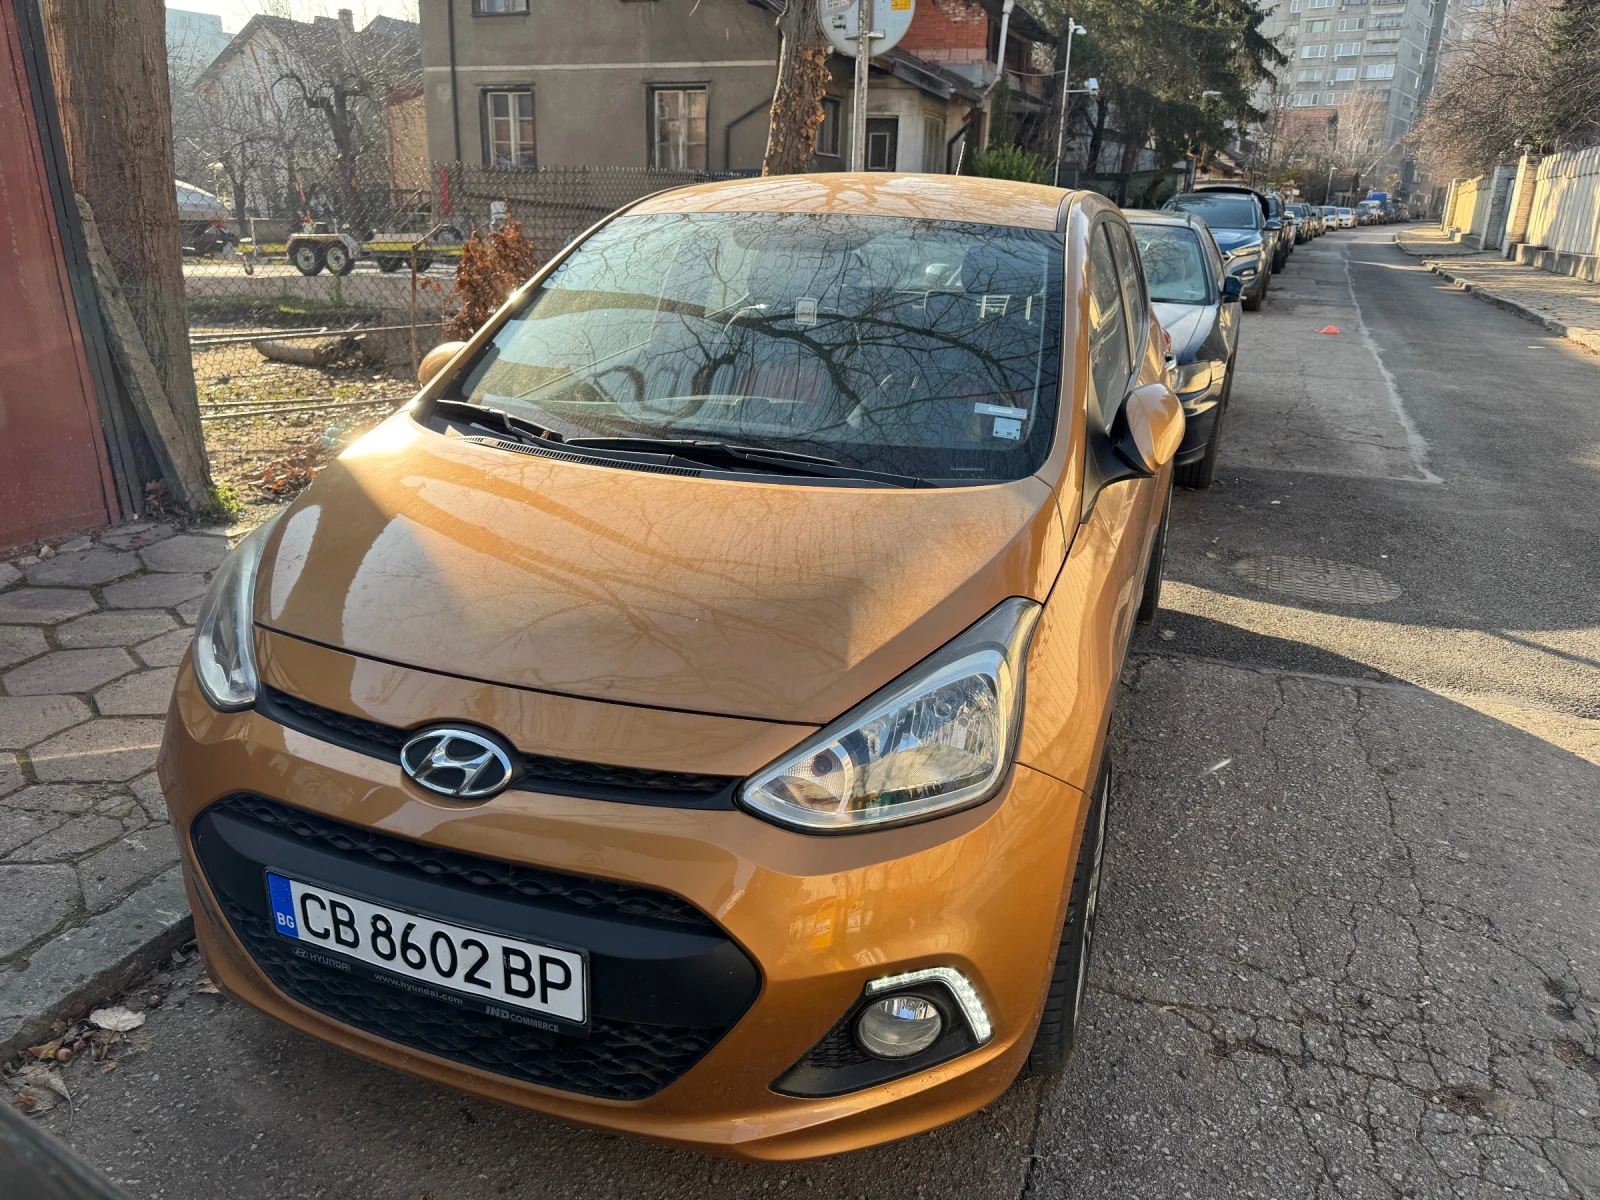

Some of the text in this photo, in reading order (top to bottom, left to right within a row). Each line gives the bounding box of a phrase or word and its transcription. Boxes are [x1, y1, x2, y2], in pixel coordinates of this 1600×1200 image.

[276, 911, 295, 929] BG
[310, 952, 351, 971] HYUNDAI
[374, 973, 464, 1005] www.hyundai.com
